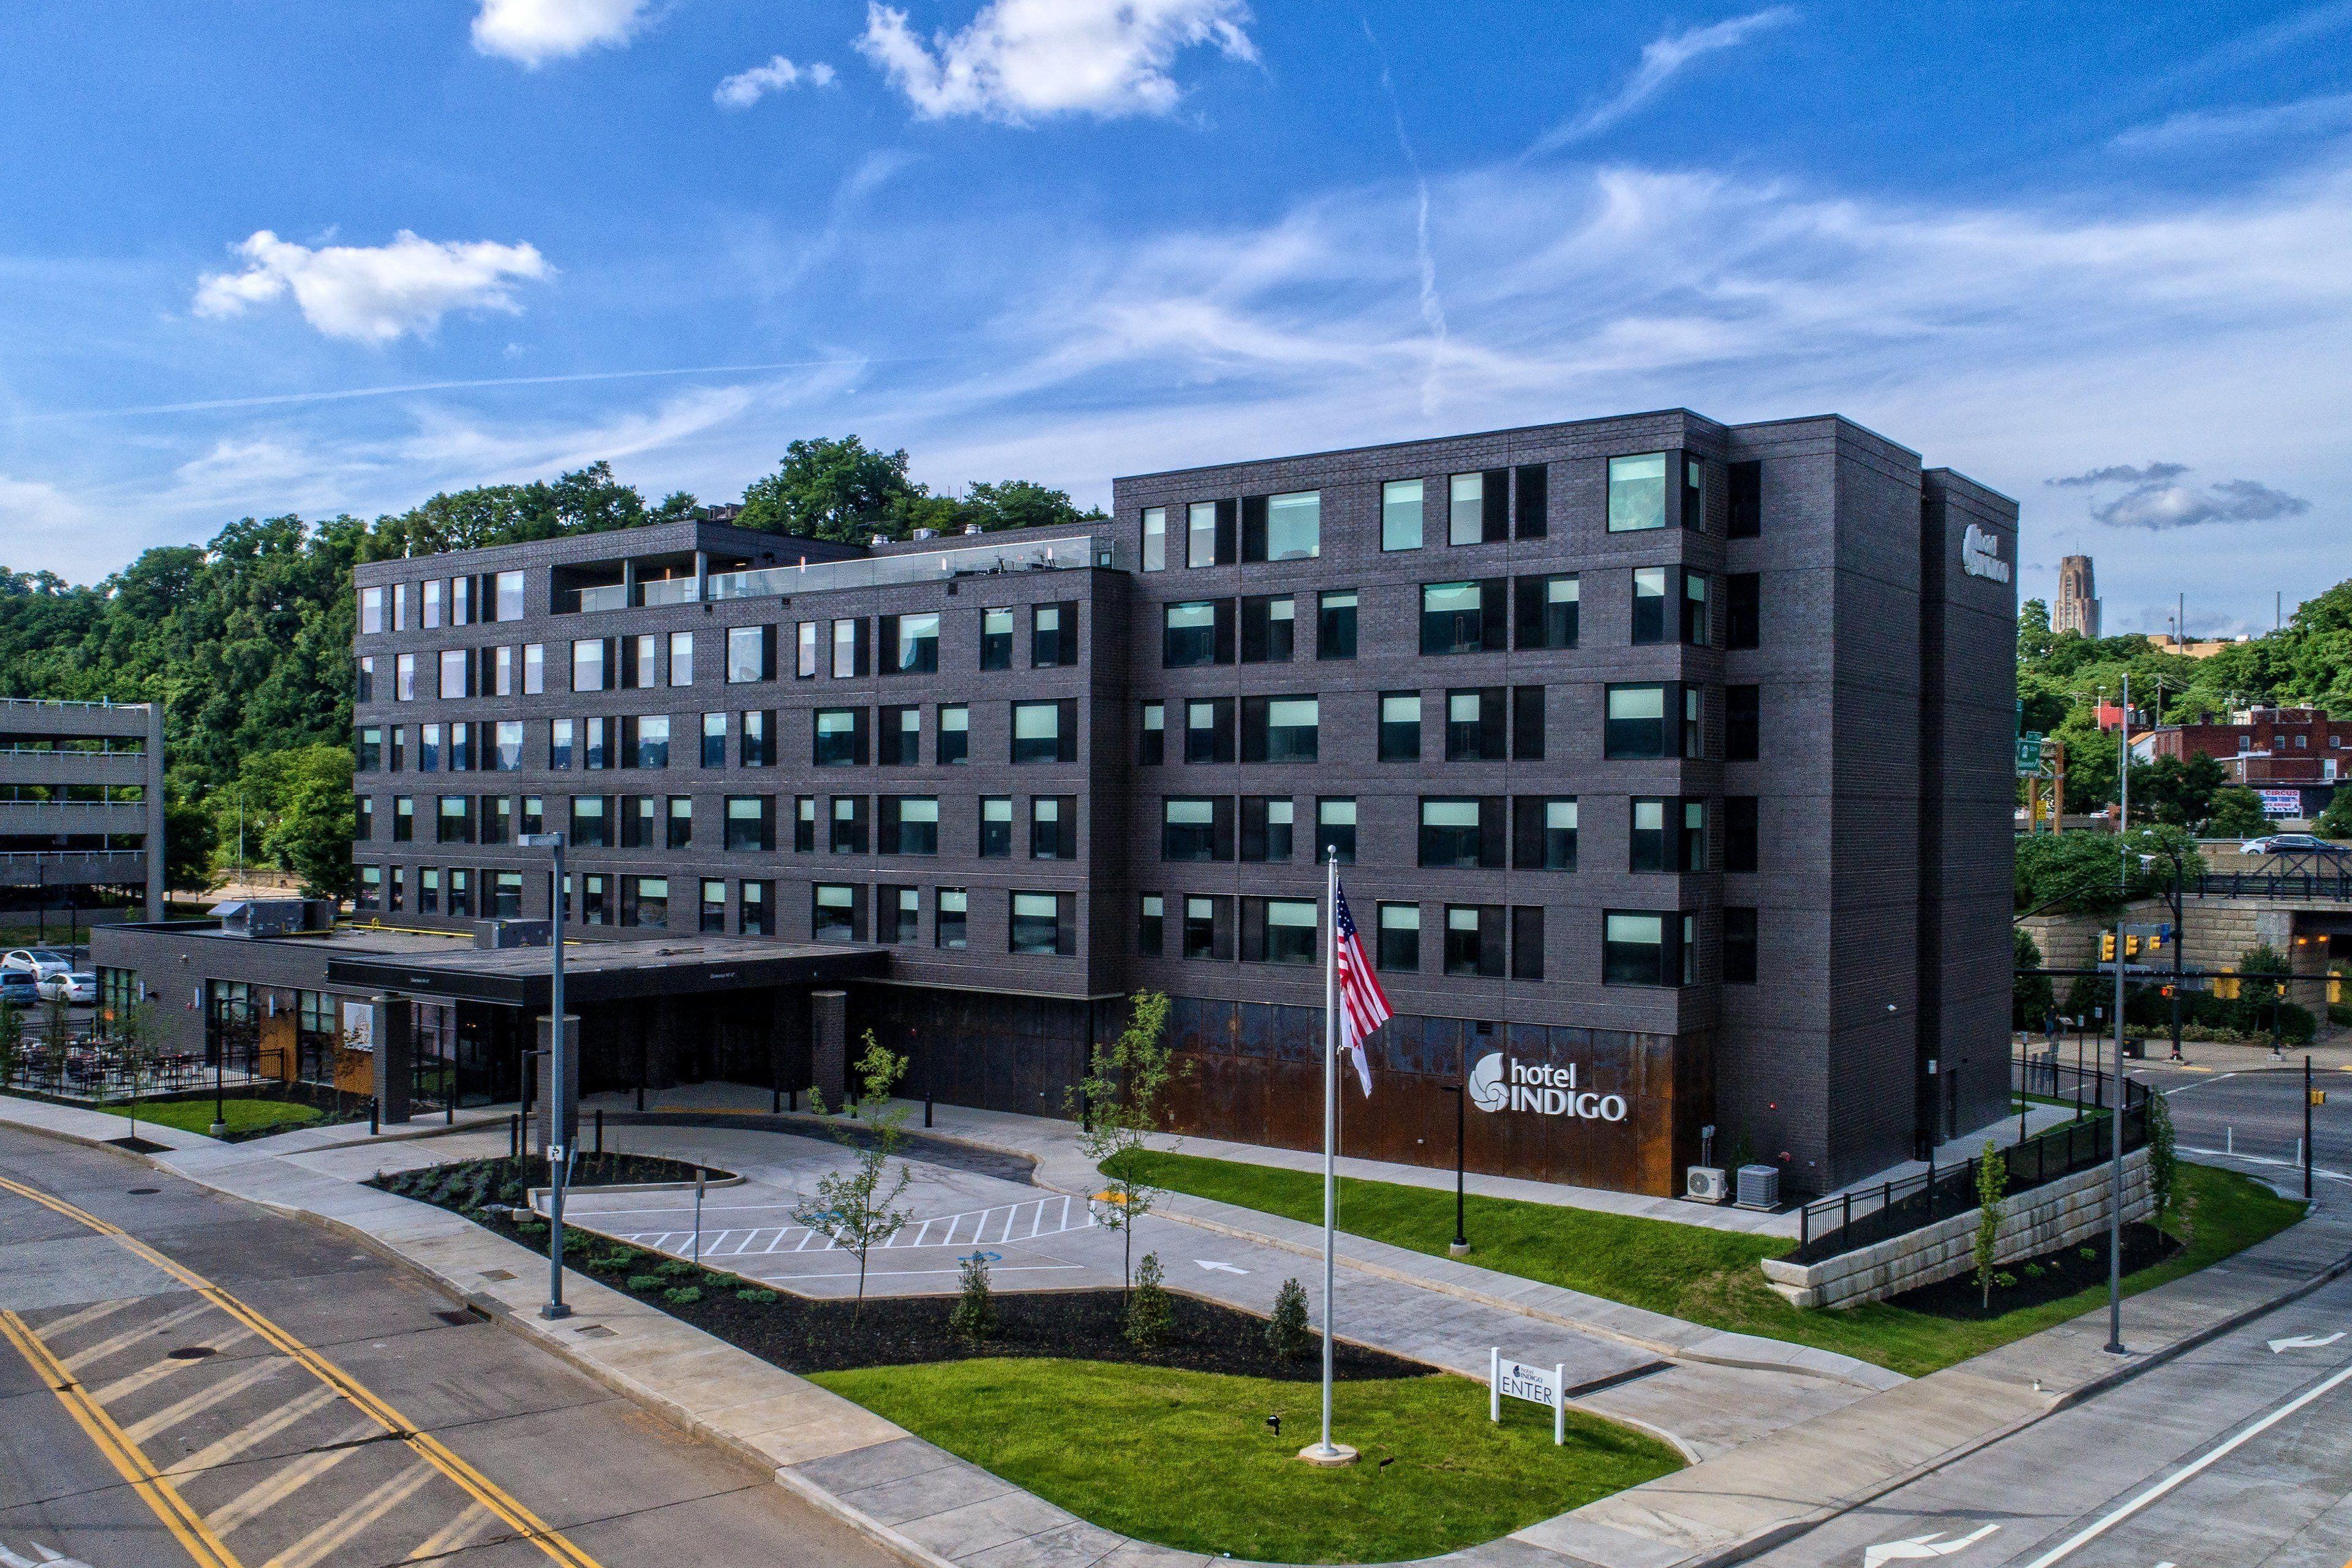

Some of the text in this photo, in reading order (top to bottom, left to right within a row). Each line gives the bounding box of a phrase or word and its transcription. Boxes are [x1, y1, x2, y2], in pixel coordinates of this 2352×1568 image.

[1511, 1058, 1577, 1088] hotel
[1511, 1085, 1627, 1121] INDIGO
[1502, 1376, 1553, 1404] ENTER
[1521, 1373, 1543, 1383] INDIGO
